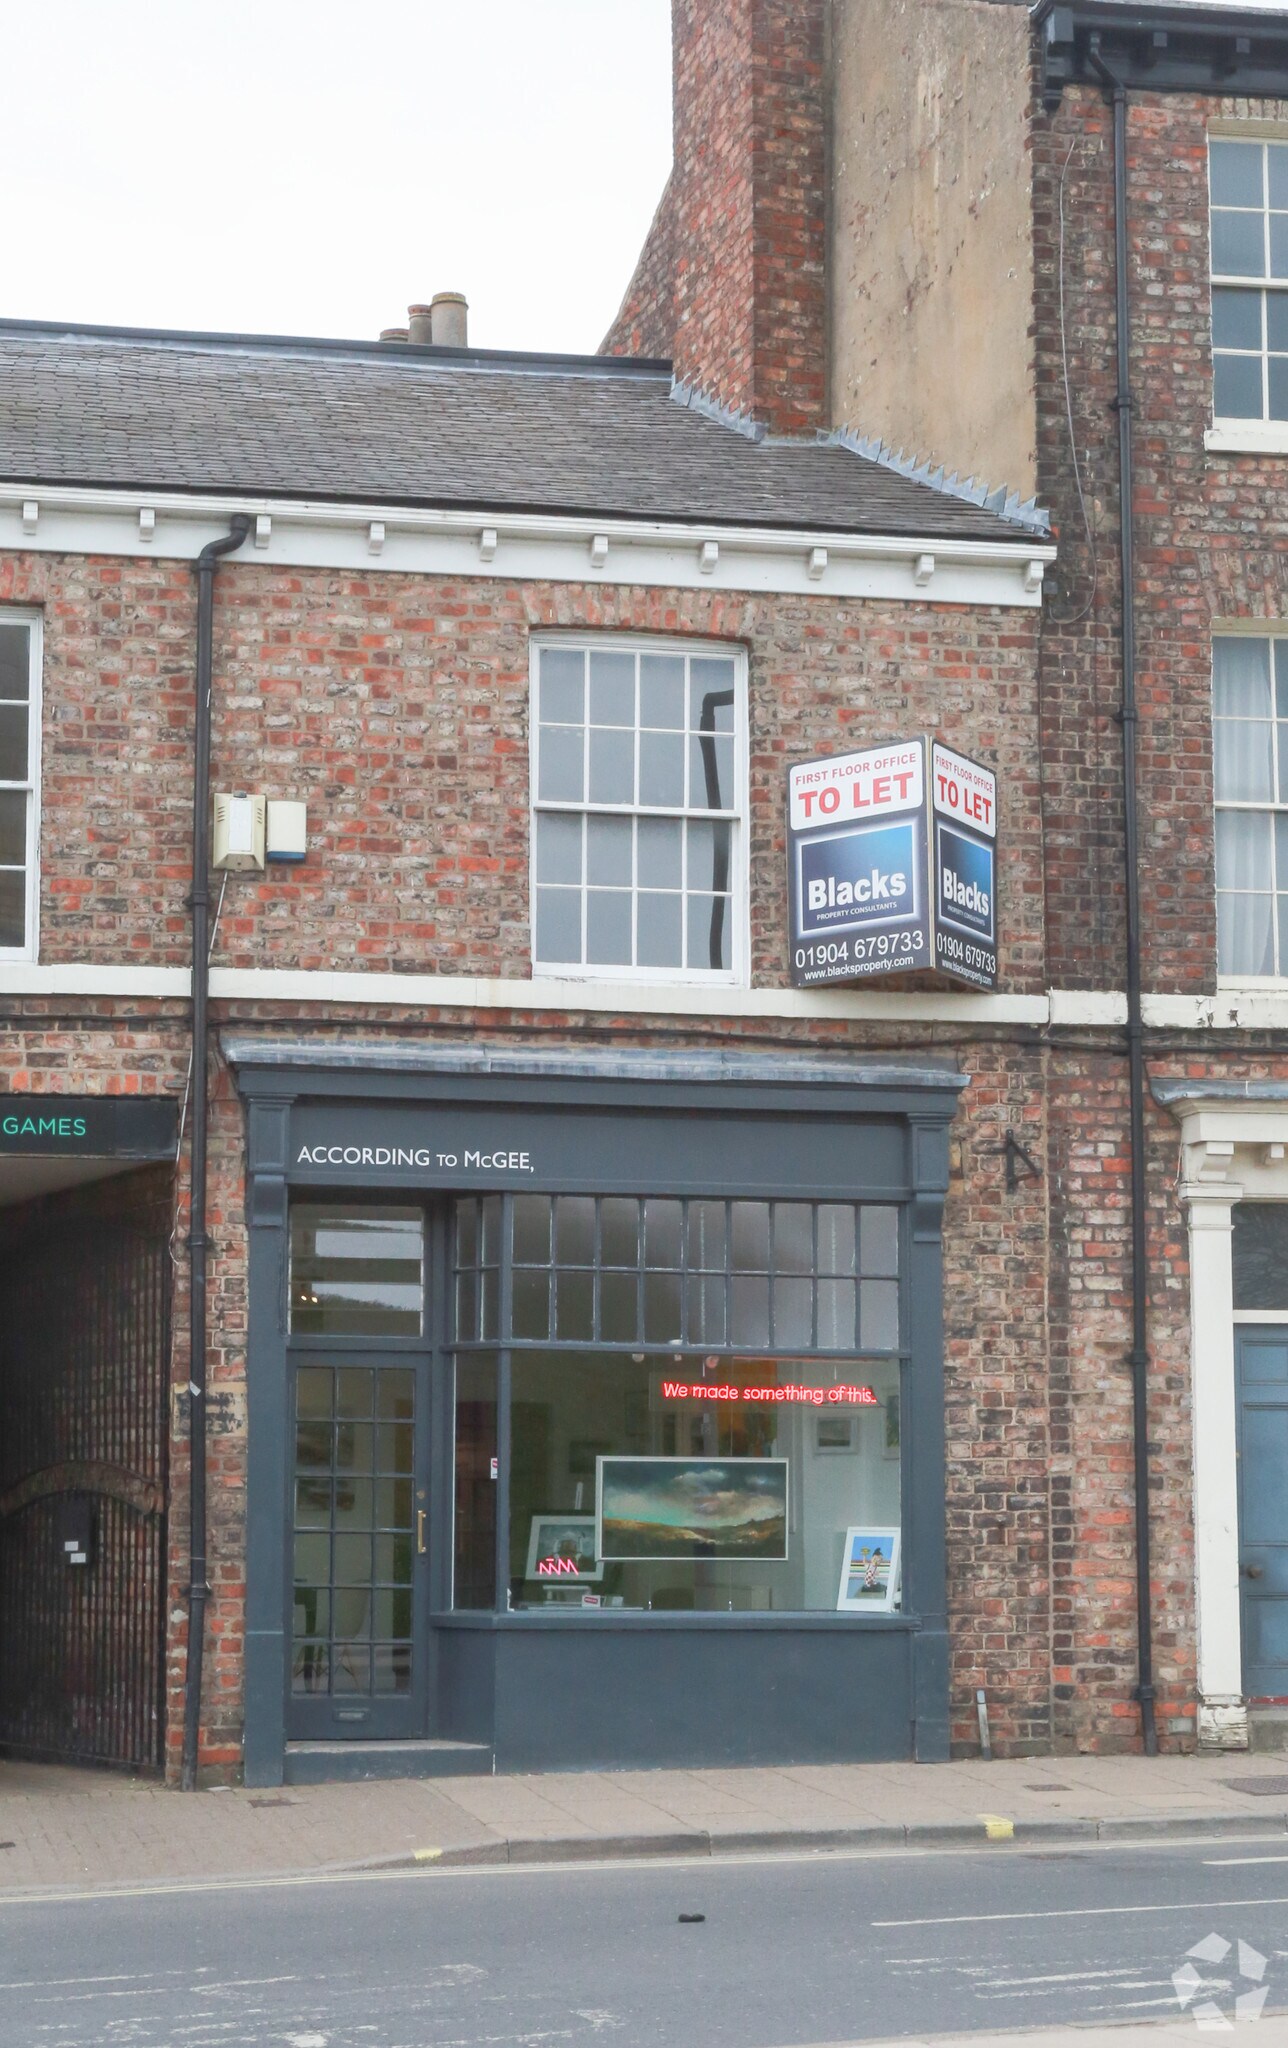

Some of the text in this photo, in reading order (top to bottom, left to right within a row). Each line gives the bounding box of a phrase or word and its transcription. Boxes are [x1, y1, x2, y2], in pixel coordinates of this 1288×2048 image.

[795, 752, 917, 786] FIRST FLOOR OFFICE
[935, 755, 993, 794] FIRST FLOOR OFFICE
[798, 771, 914, 818] TO LET
[937, 773, 992, 825] TO LET
[808, 869, 907, 911] Blacks
[943, 867, 989, 916] Blacks
[816, 901, 898, 921] PROPERTY CONSULTANTS
[795, 929, 924, 968] 01904 679733
[936, 932, 996, 974] 01904 679733
[804, 956, 914, 981] www.blacksproperty.com
[3, 1117, 86, 1136] GAMES
[297, 1146, 430, 1167] ACCORDING
[663, 1382, 688, 1398] We
[692, 1384, 739, 1400] made
[743, 1385, 824, 1405] something
[828, 1385, 846, 1402] of
